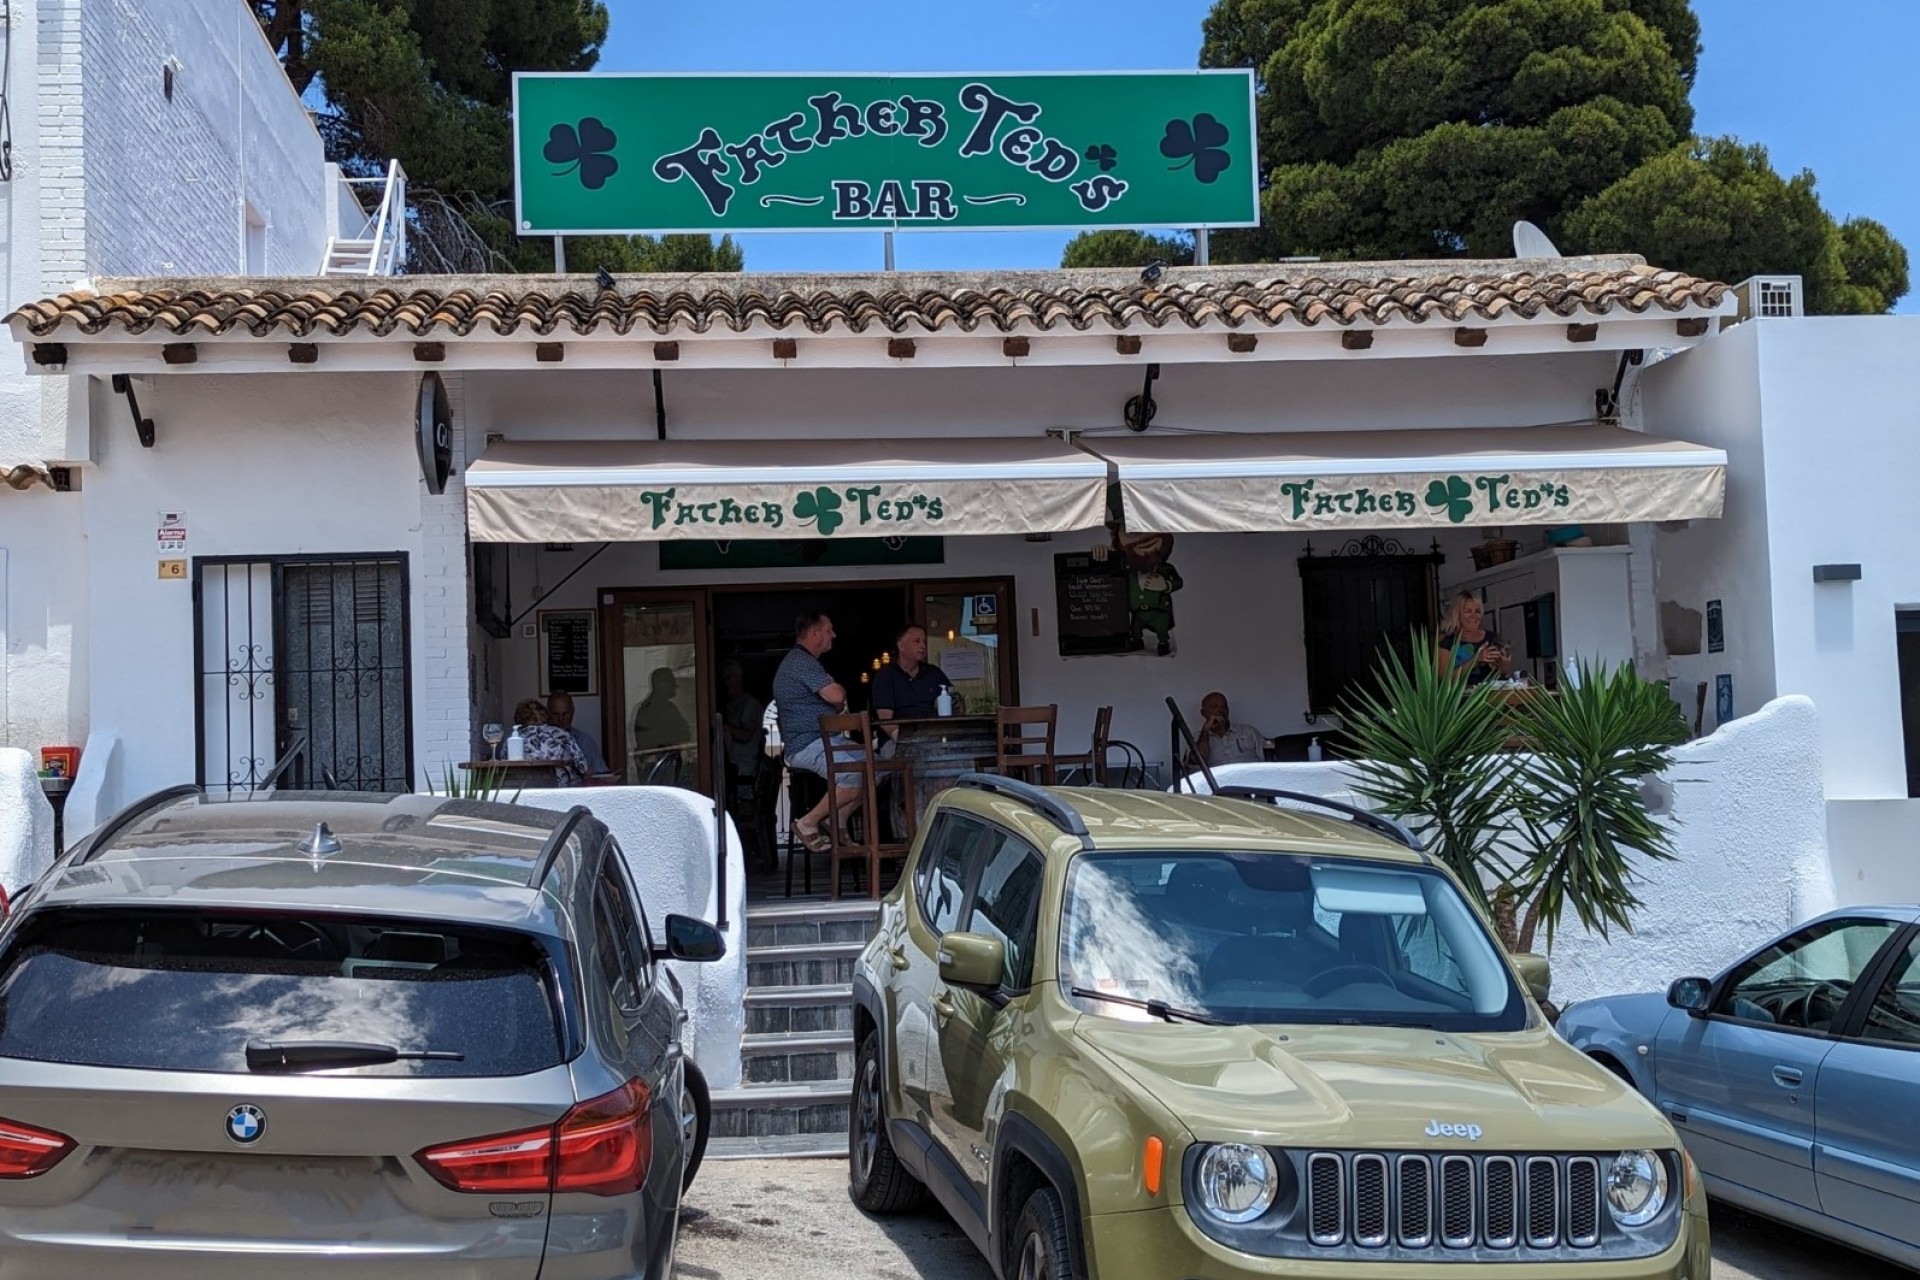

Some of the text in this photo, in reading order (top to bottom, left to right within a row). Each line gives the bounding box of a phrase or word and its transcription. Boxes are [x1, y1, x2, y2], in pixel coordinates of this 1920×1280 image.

[831, 180, 958, 220] BAR
[171, 564, 180, 575] 6
[228, 1104, 265, 1120] BMW
[1424, 1119, 1483, 1141] Jeep
